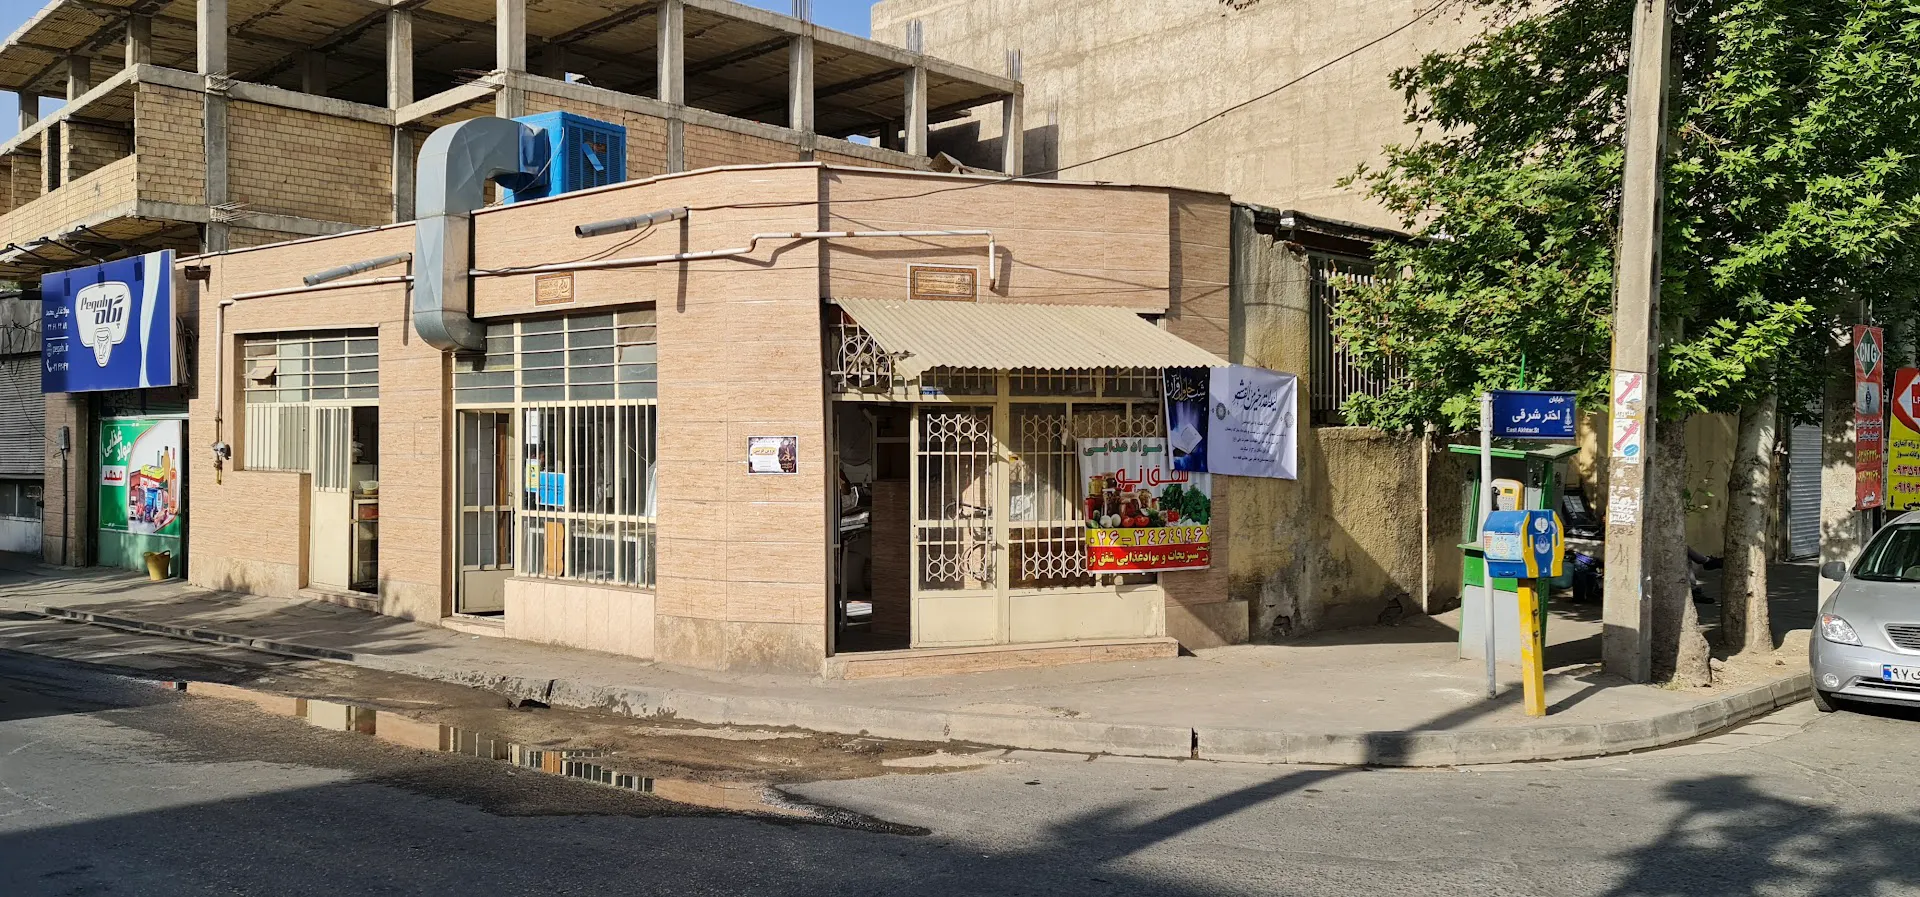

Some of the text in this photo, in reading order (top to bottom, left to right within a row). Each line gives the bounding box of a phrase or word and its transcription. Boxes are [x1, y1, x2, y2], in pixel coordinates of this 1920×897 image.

[81, 294, 107, 312] Pegah
[94, 293, 125, 329] پگاه
[1860, 342, 1877, 362] CNG
[1166, 374, 1181, 399] قرآن
[1548, 396, 1564, 404] خیابان
[1512, 408, 1561, 423] اختر شرقی
[104, 426, 132, 461] مواد غذایی
[1083, 439, 1128, 456] غذایی
[1130, 439, 1163, 456] مواد
[104, 469, 122, 480] محمد
[1115, 465, 1143, 490] نو
[1089, 551, 1097, 566] نو
[1098, 554, 1115, 566] شفق
[1161, 555, 1166, 564] و
[1168, 550, 1199, 562] سبزیجات
[1893, 667, 1909, 680] ۹۷
